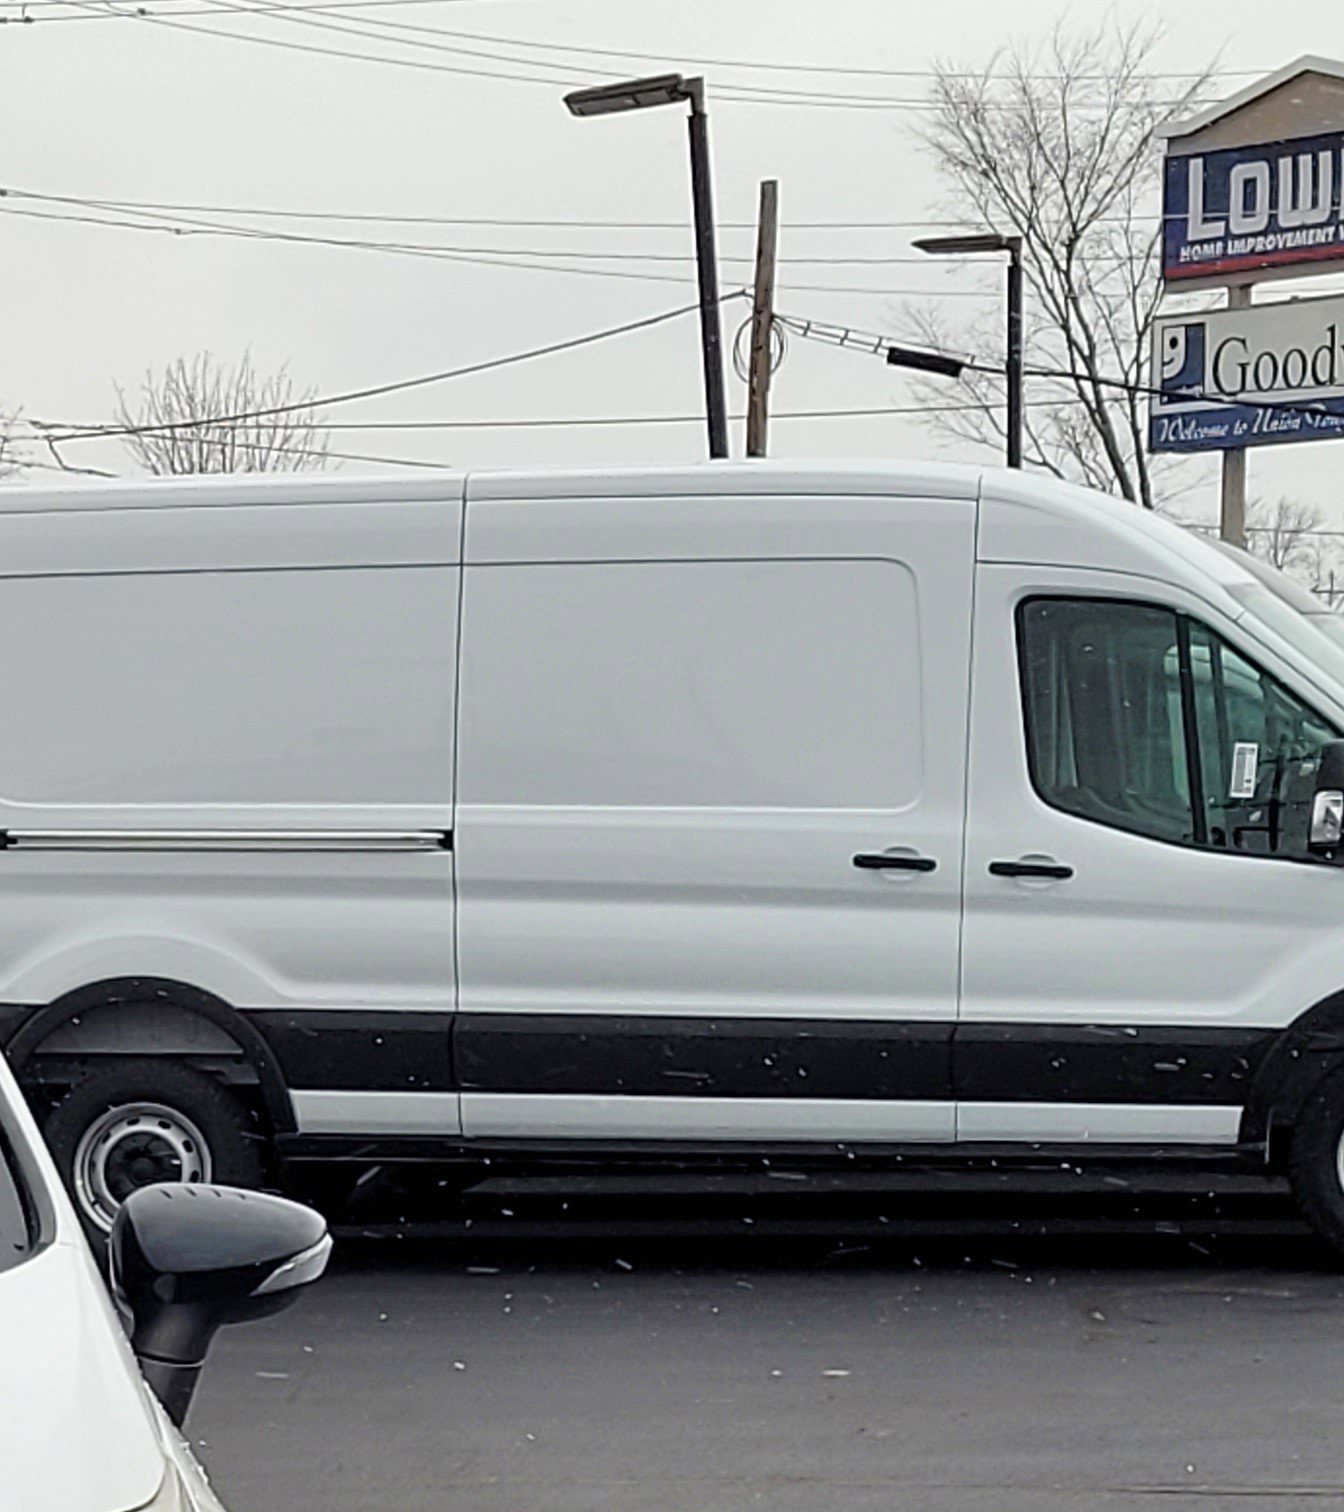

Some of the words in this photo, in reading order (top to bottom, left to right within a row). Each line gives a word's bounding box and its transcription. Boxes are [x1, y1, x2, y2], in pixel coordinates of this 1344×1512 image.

[1186, 148, 1344, 241] LOW
[1179, 241, 1224, 263] HOME
[1227, 226, 1336, 255] IMPROVEMENT
[1212, 323, 1344, 398] Good
